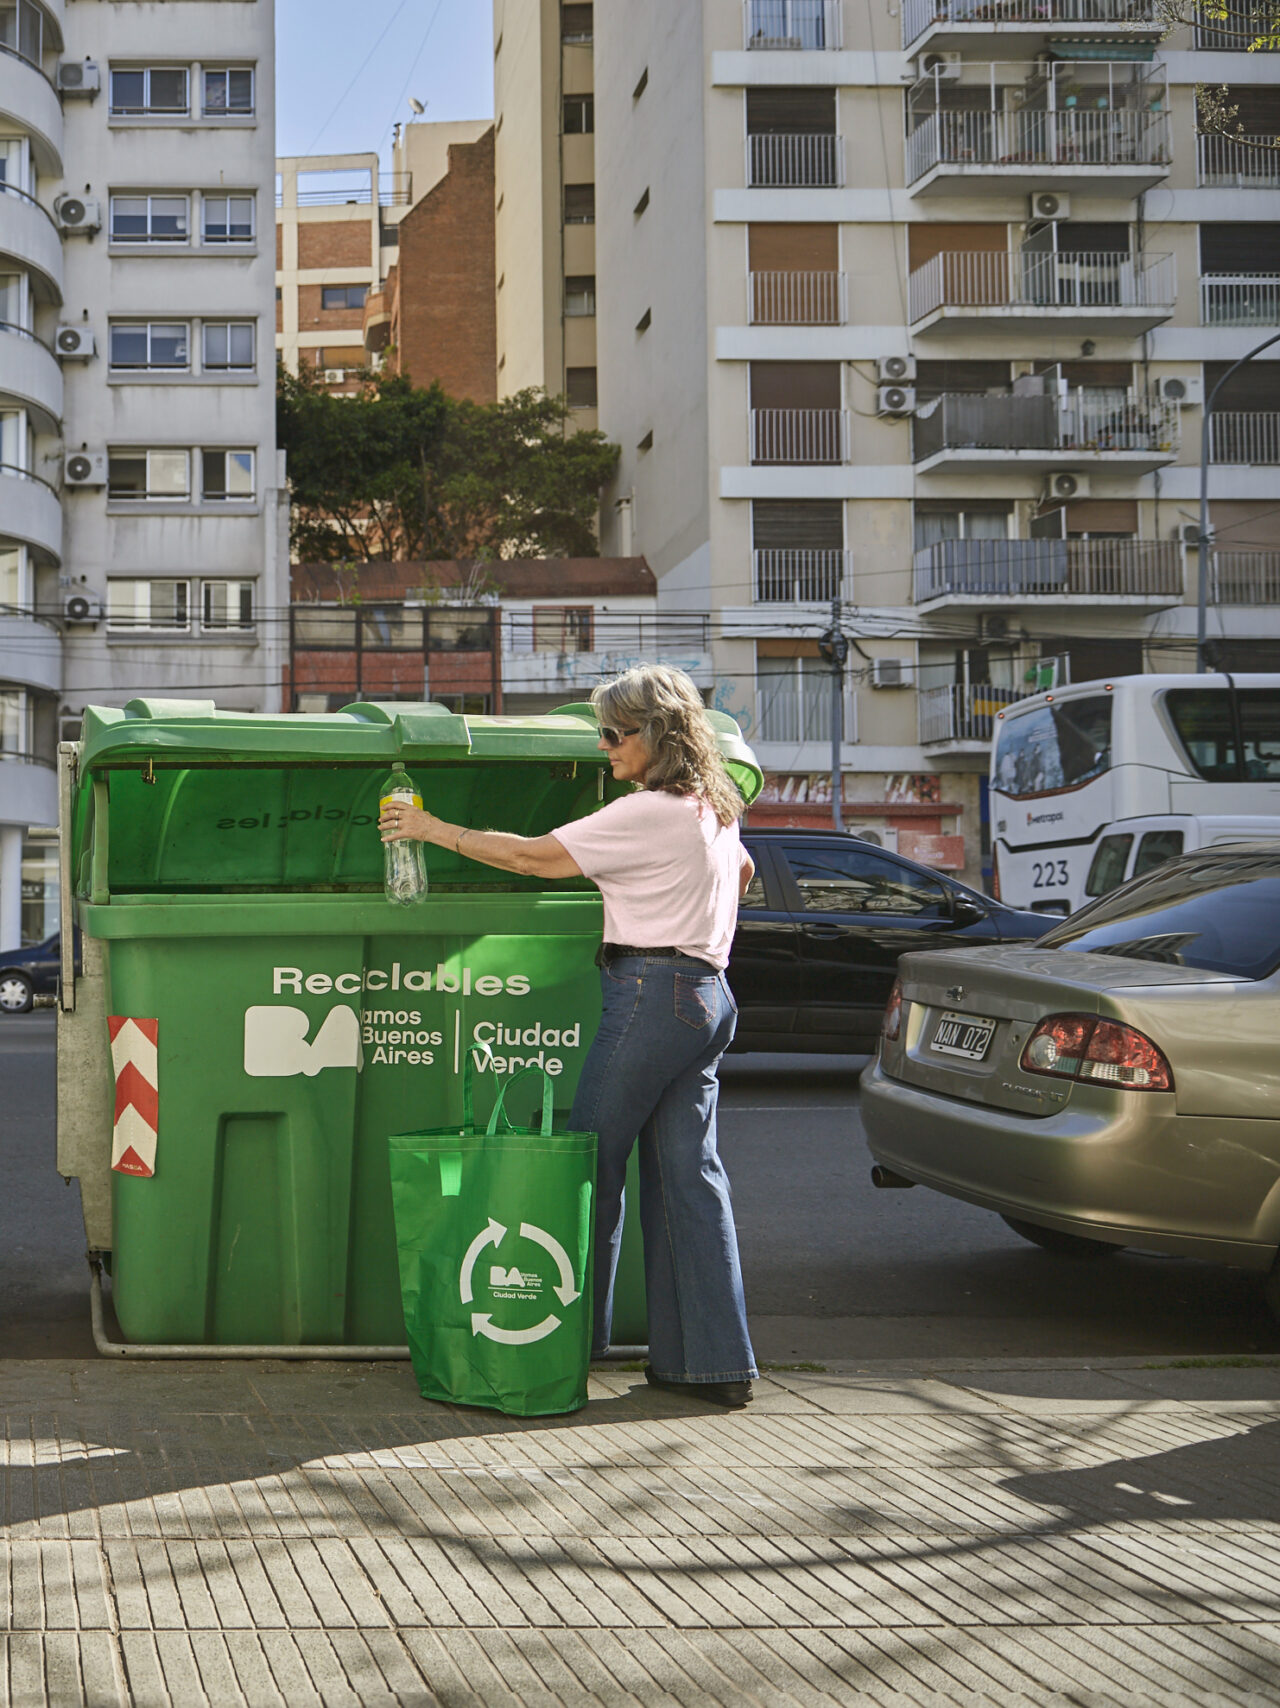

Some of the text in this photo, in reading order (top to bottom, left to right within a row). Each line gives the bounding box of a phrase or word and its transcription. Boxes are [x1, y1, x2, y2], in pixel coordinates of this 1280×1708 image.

[1032, 860, 1069, 888] 223
[273, 962, 531, 996] Reciclables
[244, 1004, 364, 1076] BA
[362, 1026, 443, 1045] Buenos
[473, 1021, 581, 1048] Ciudad
[934, 1021, 989, 1052] NAN 072
[371, 1047, 434, 1066] Aires
[473, 1050, 564, 1076] Verde
[490, 1266, 526, 1288] BA
[493, 1291, 516, 1299] Ciudad
